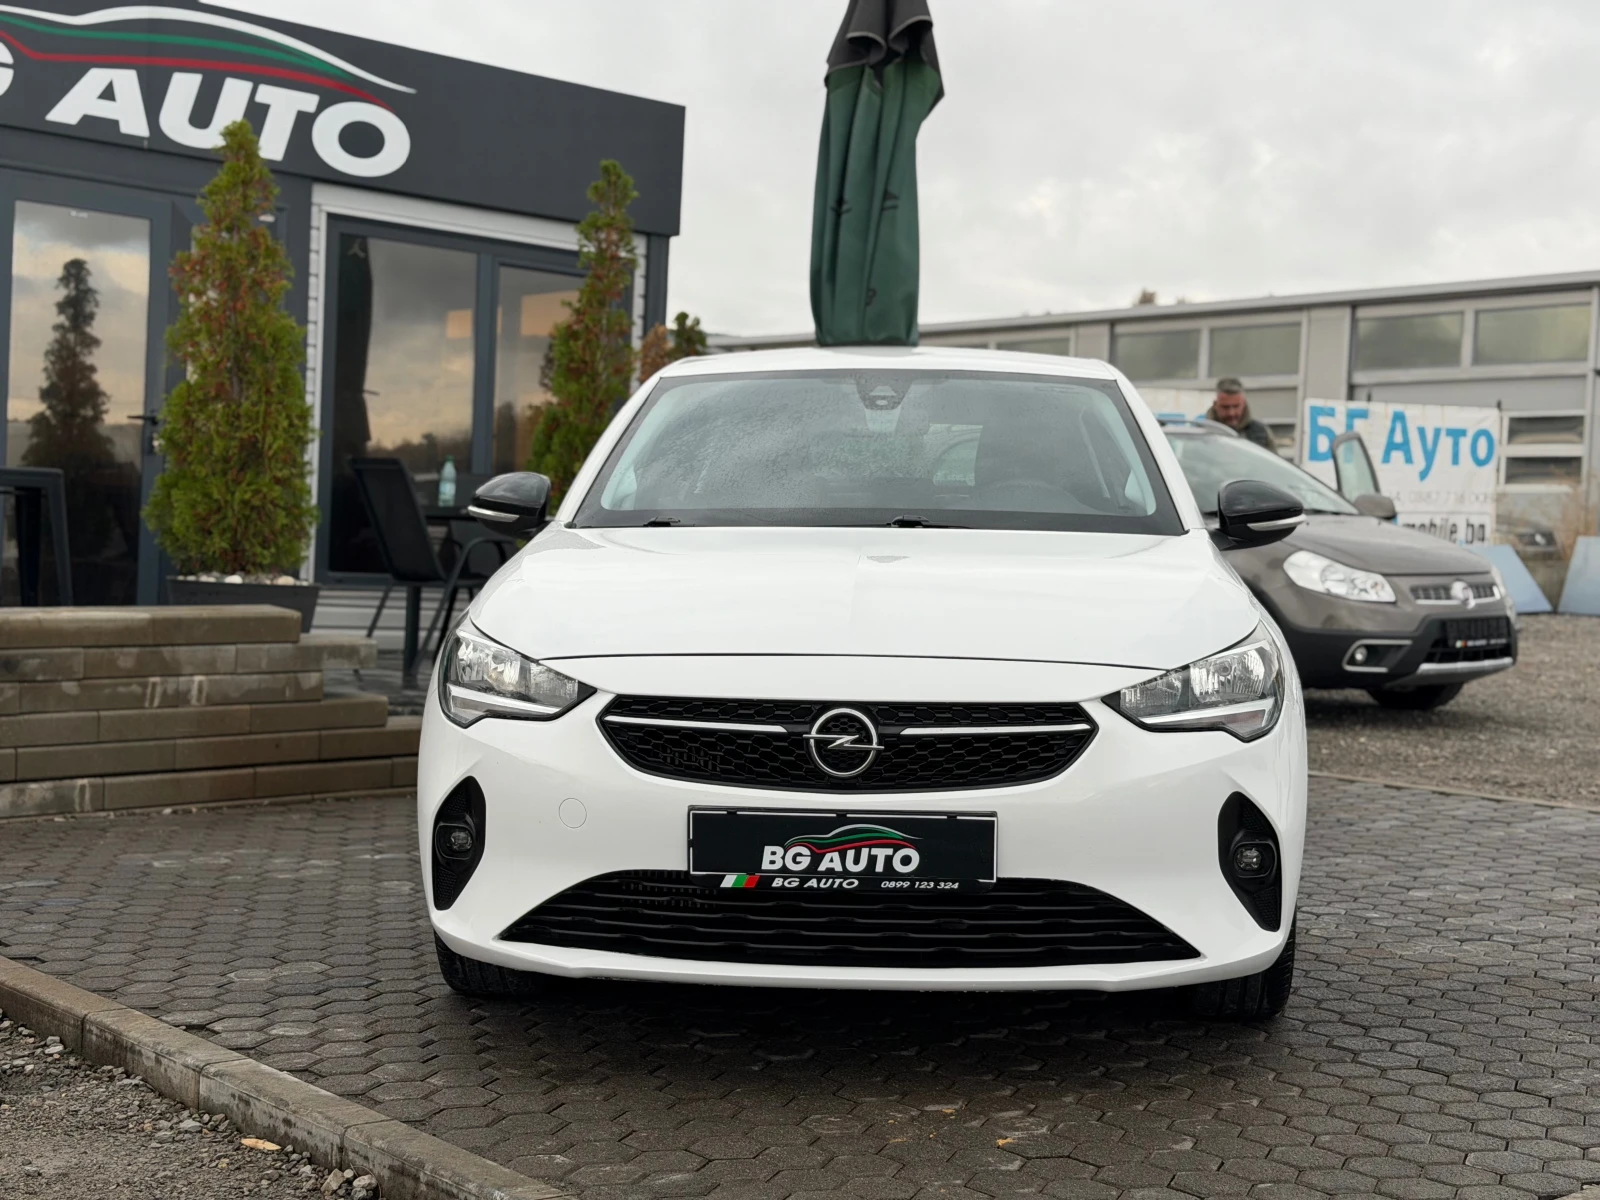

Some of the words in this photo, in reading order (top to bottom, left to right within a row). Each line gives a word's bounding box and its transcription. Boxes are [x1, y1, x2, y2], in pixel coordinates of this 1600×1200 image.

[45, 67, 411, 178] AUTO
[1381, 410, 1495, 482] Ауто
[1402, 517, 1485, 544] bile.bg
[761, 845, 812, 871] BG
[817, 847, 920, 873] AUTO
[771, 877, 800, 888] BG
[803, 878, 859, 889] AUTO
[880, 880, 910, 888] 0899
[914, 881, 934, 889] 123
[936, 881, 959, 889] 324
